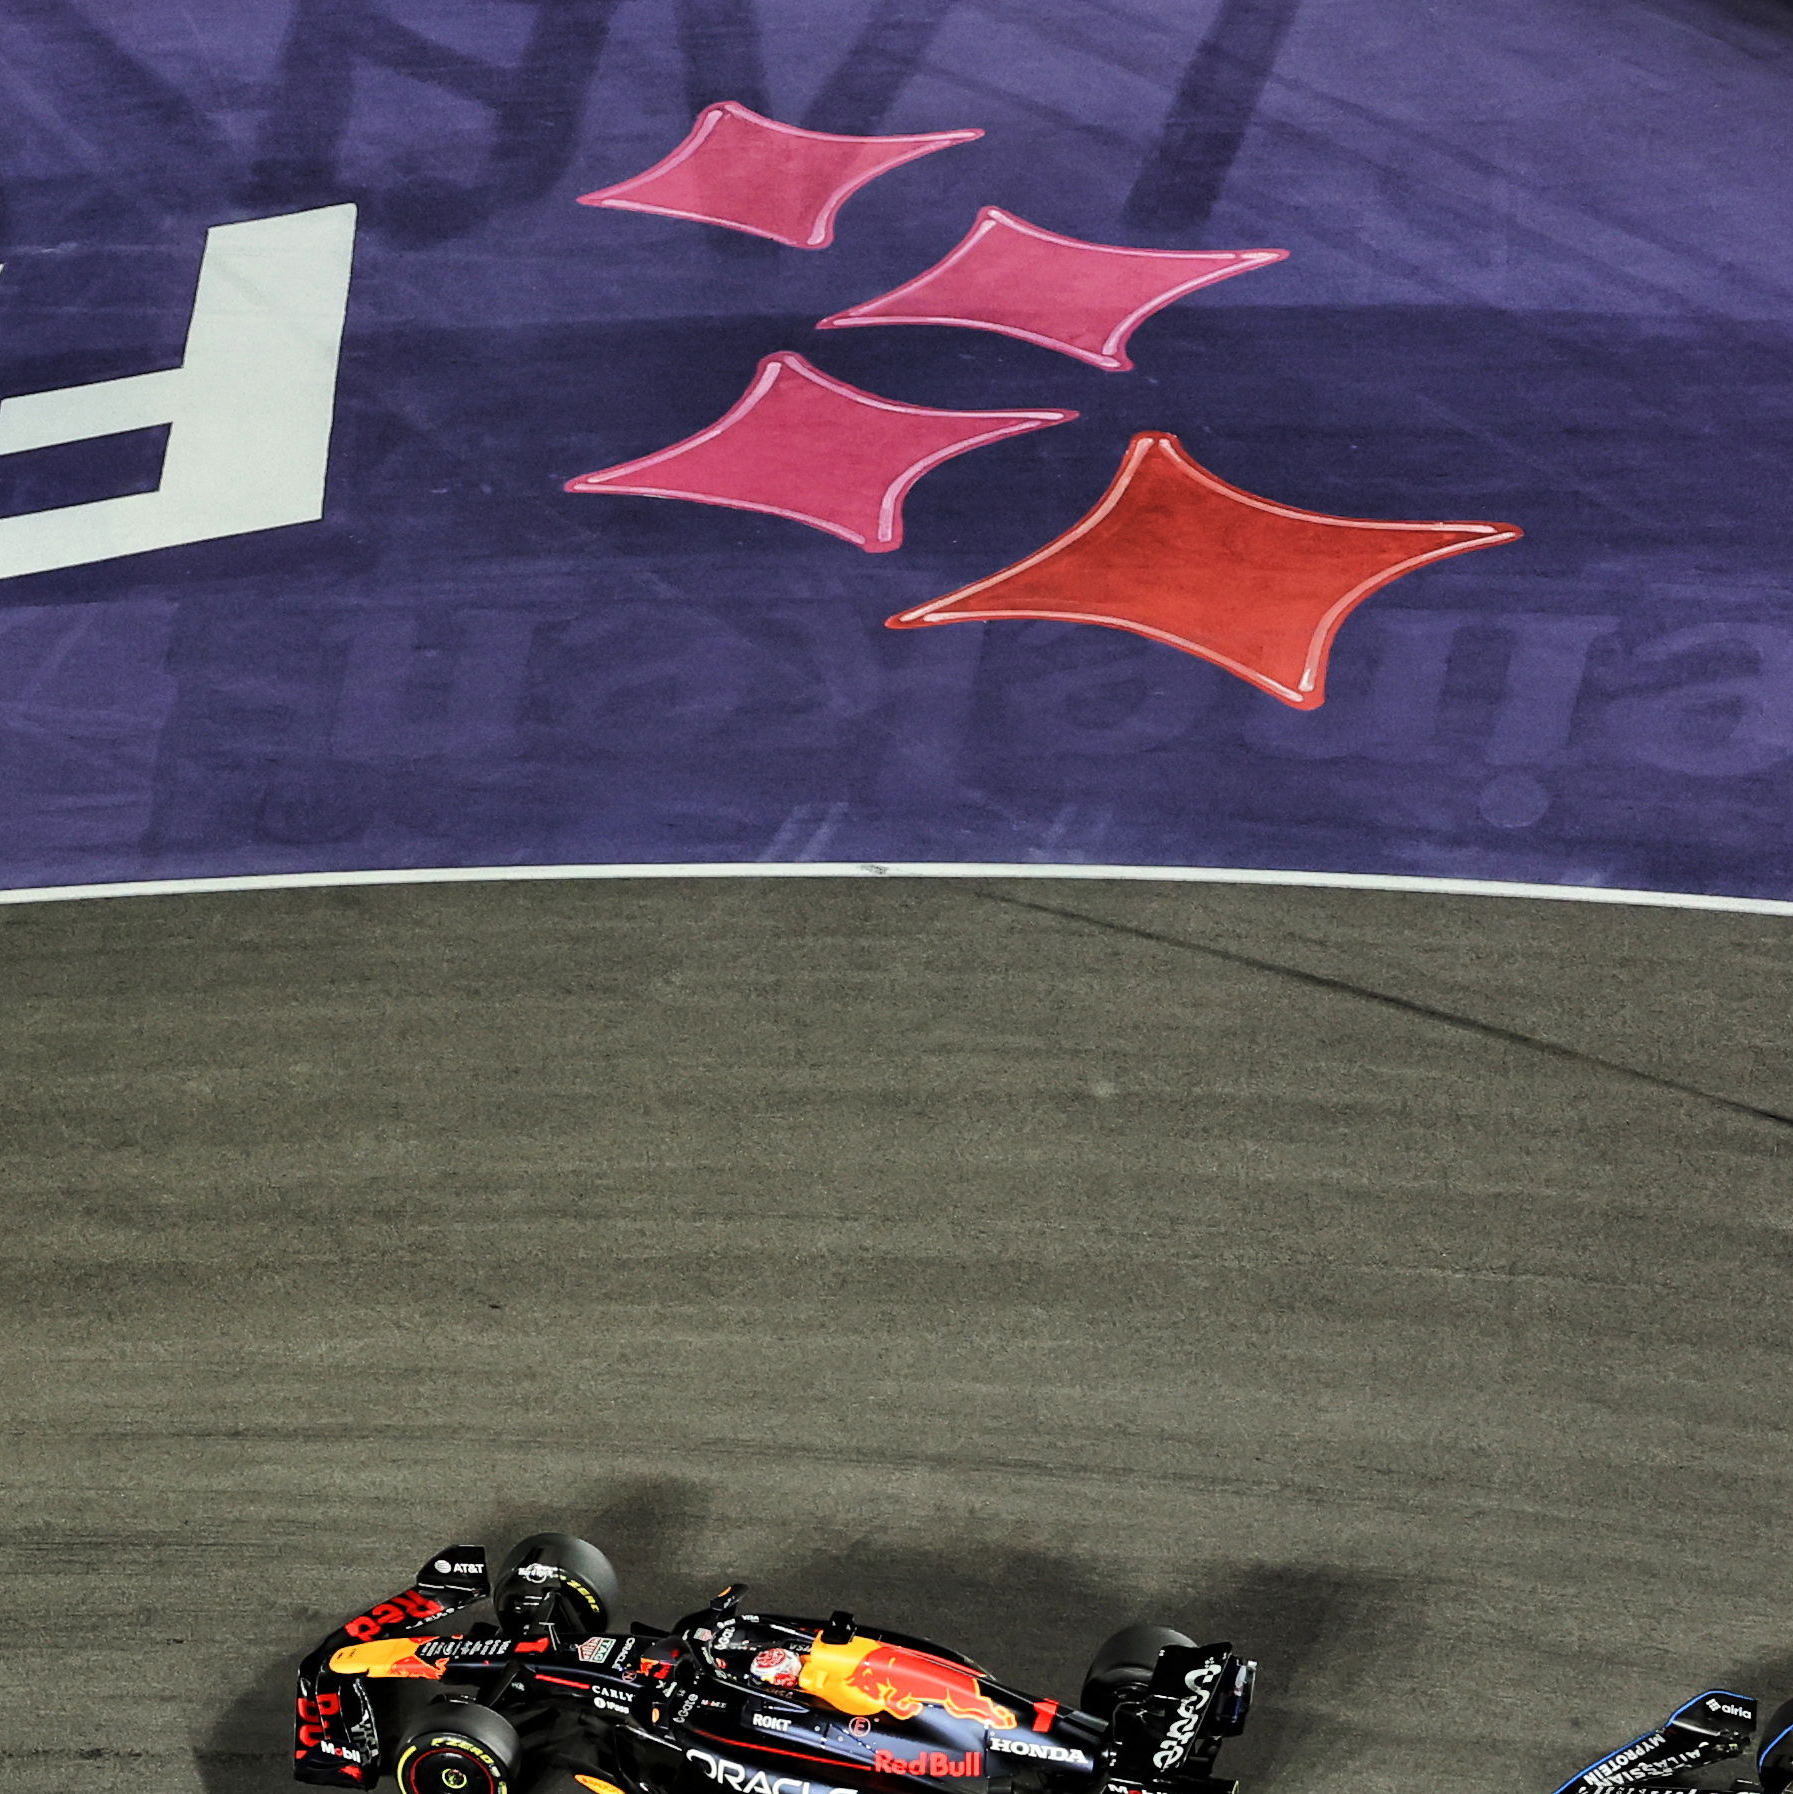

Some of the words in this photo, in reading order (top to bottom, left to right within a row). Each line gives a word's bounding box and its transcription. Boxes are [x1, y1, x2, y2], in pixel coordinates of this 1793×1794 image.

[453, 1562, 484, 1574] AT&T
[591, 1685, 634, 1702] CARLY
[1722, 1703, 1752, 1719] airia
[752, 1713, 792, 1732] ROKT
[320, 1740, 362, 1763] Mobil
[990, 1737, 1089, 1764] HONDA
[1583, 1732, 1666, 1786] MYPROTEIN
[874, 1750, 927, 1776] Red
[929, 1752, 982, 1778] Bull
